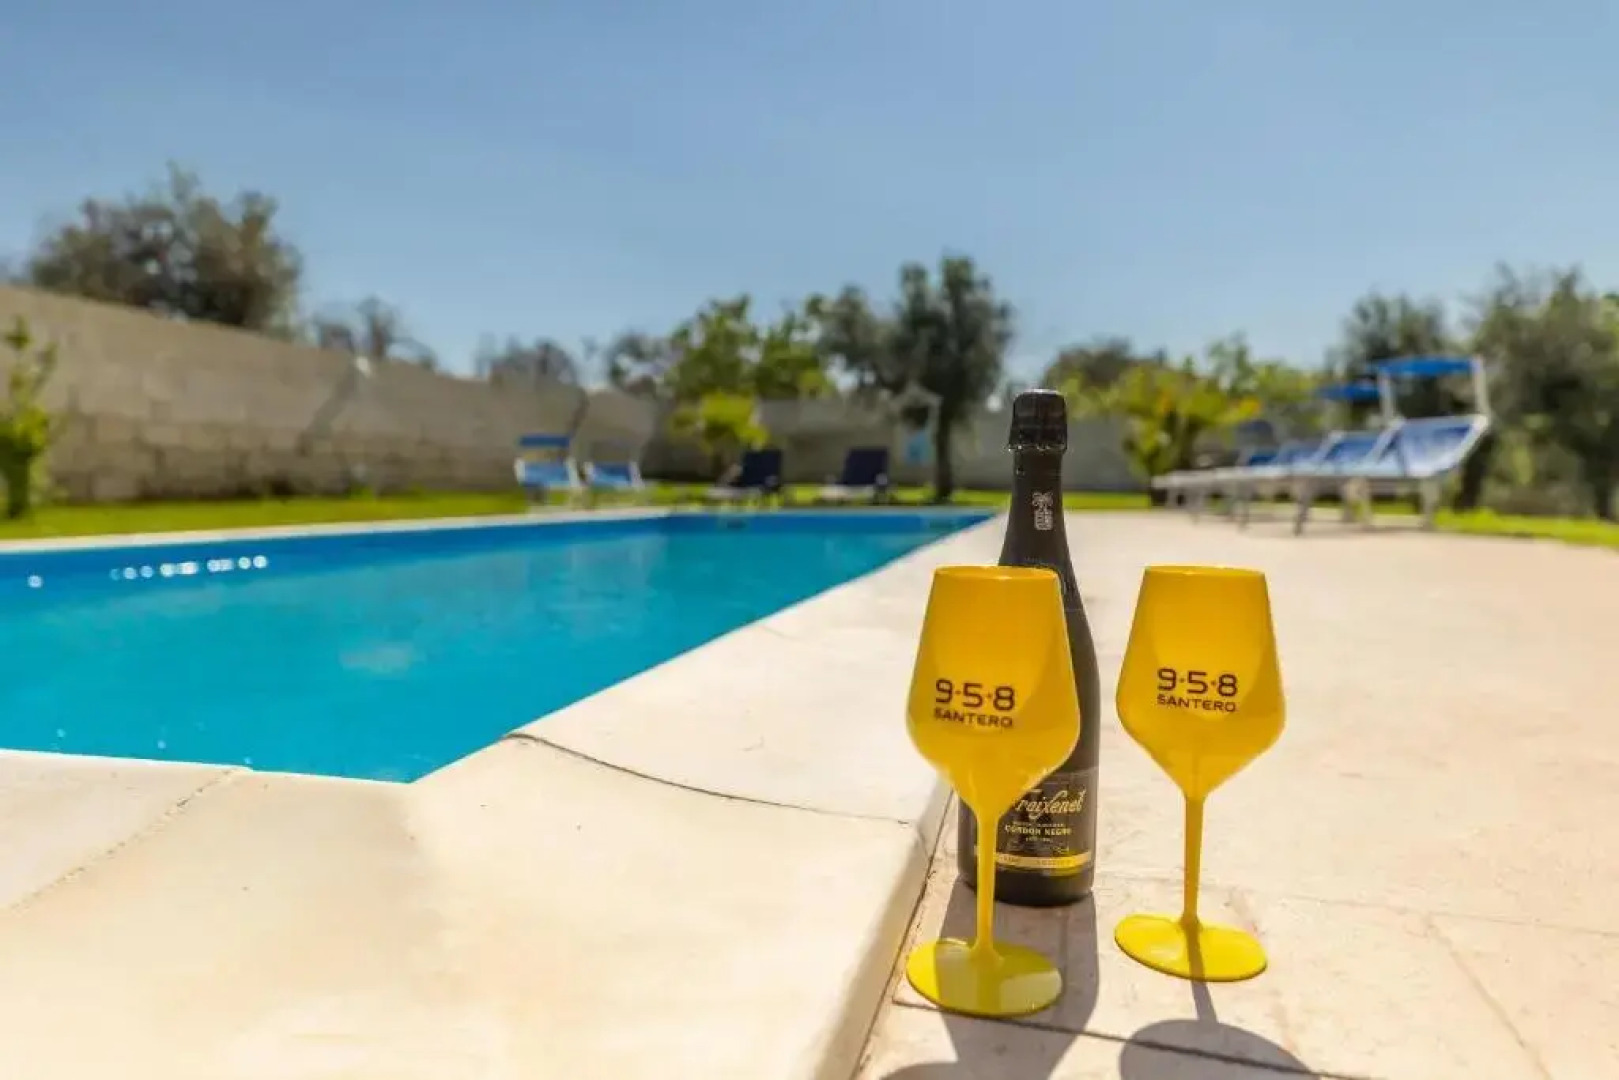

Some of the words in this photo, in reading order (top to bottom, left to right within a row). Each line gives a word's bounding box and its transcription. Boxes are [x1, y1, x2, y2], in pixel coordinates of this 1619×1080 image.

[1157, 693, 1236, 712] SANTERO
[934, 707, 1013, 728] SANTERO
[1015, 785, 1087, 820] reixenet
